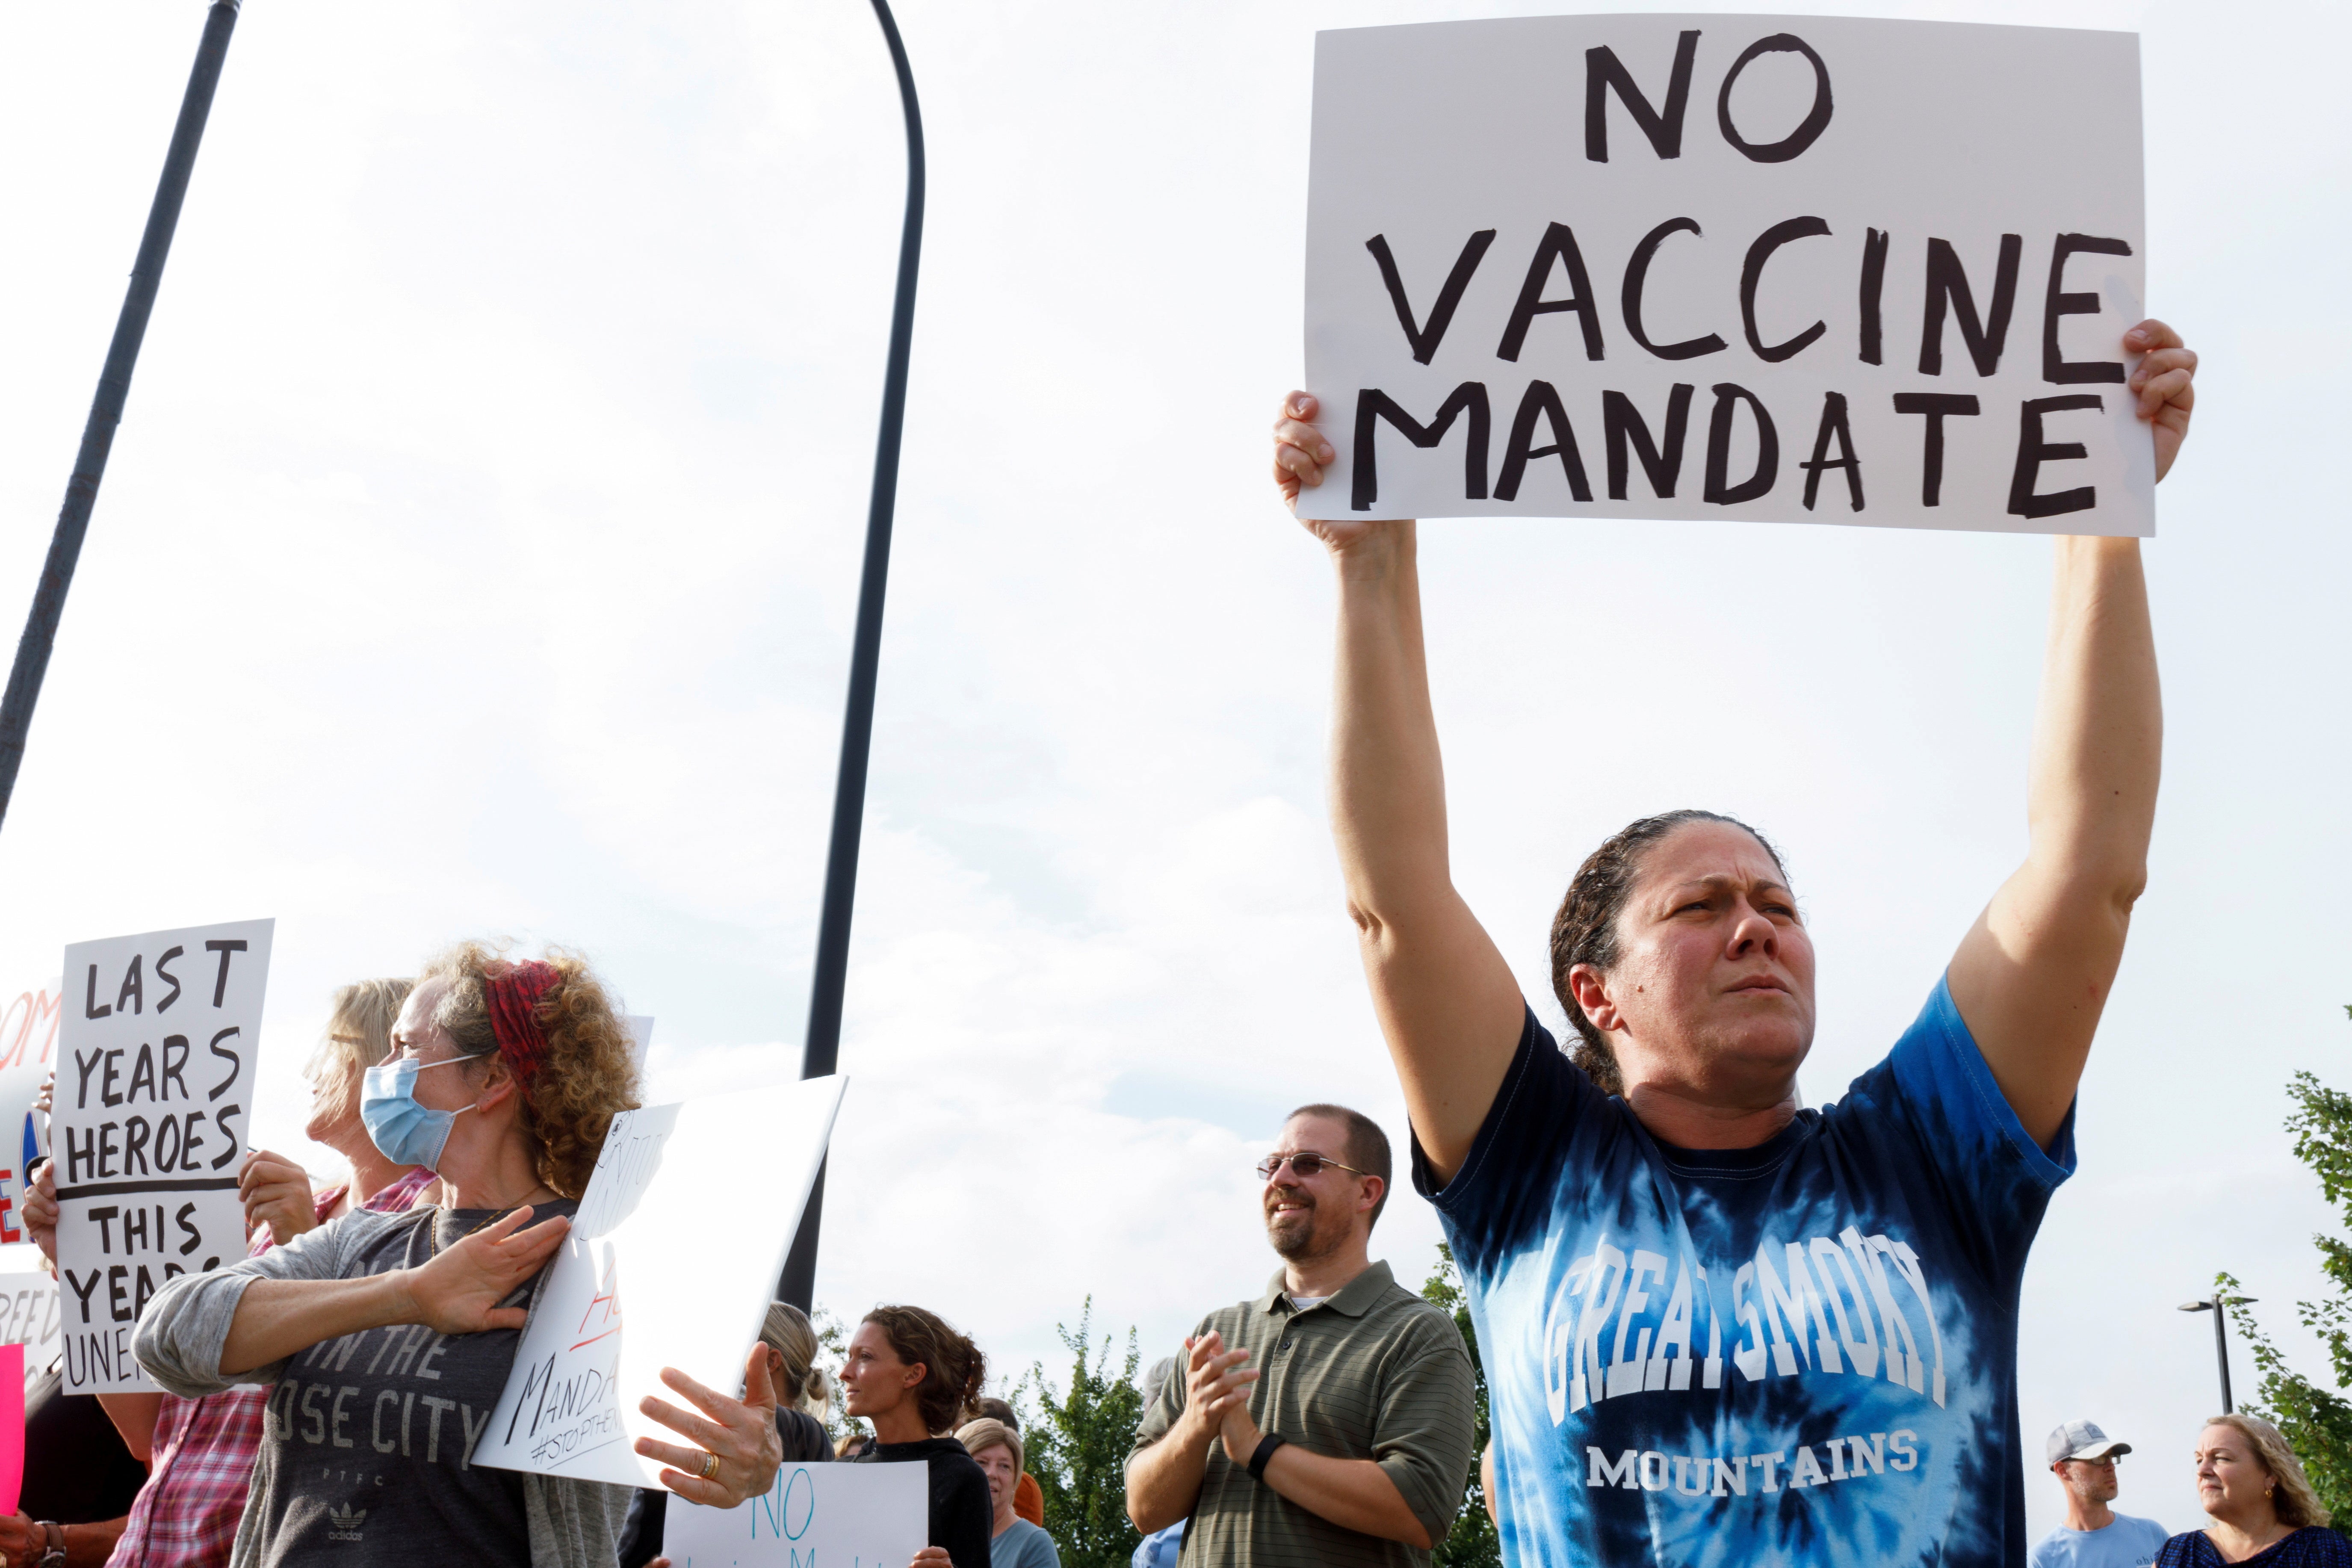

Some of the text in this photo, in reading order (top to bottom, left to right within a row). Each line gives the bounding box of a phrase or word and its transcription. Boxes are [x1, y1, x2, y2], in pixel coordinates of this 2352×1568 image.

[1585, 29, 1834, 163] NO
[1365, 216, 2133, 384] VACCINE
[1350, 379, 2105, 519] MANDATE
[86, 939, 248, 1020] LAST
[0, 988, 62, 1070] OM
[75, 1026, 240, 1109] YEARS
[66, 1104, 242, 1184] HEROES
[88, 1202, 202, 1256] THIS
[64, 1256, 221, 1324] YEA
[1543, 1225, 1947, 1428] GREAT SMOKY
[366, 1324, 447, 1380] THE
[372, 1389, 490, 1471] CITY
[1586, 1429, 1918, 1497] MOUNTAINS
[328, 1529, 363, 1542] adidas
[752, 1468, 814, 1541] NO
